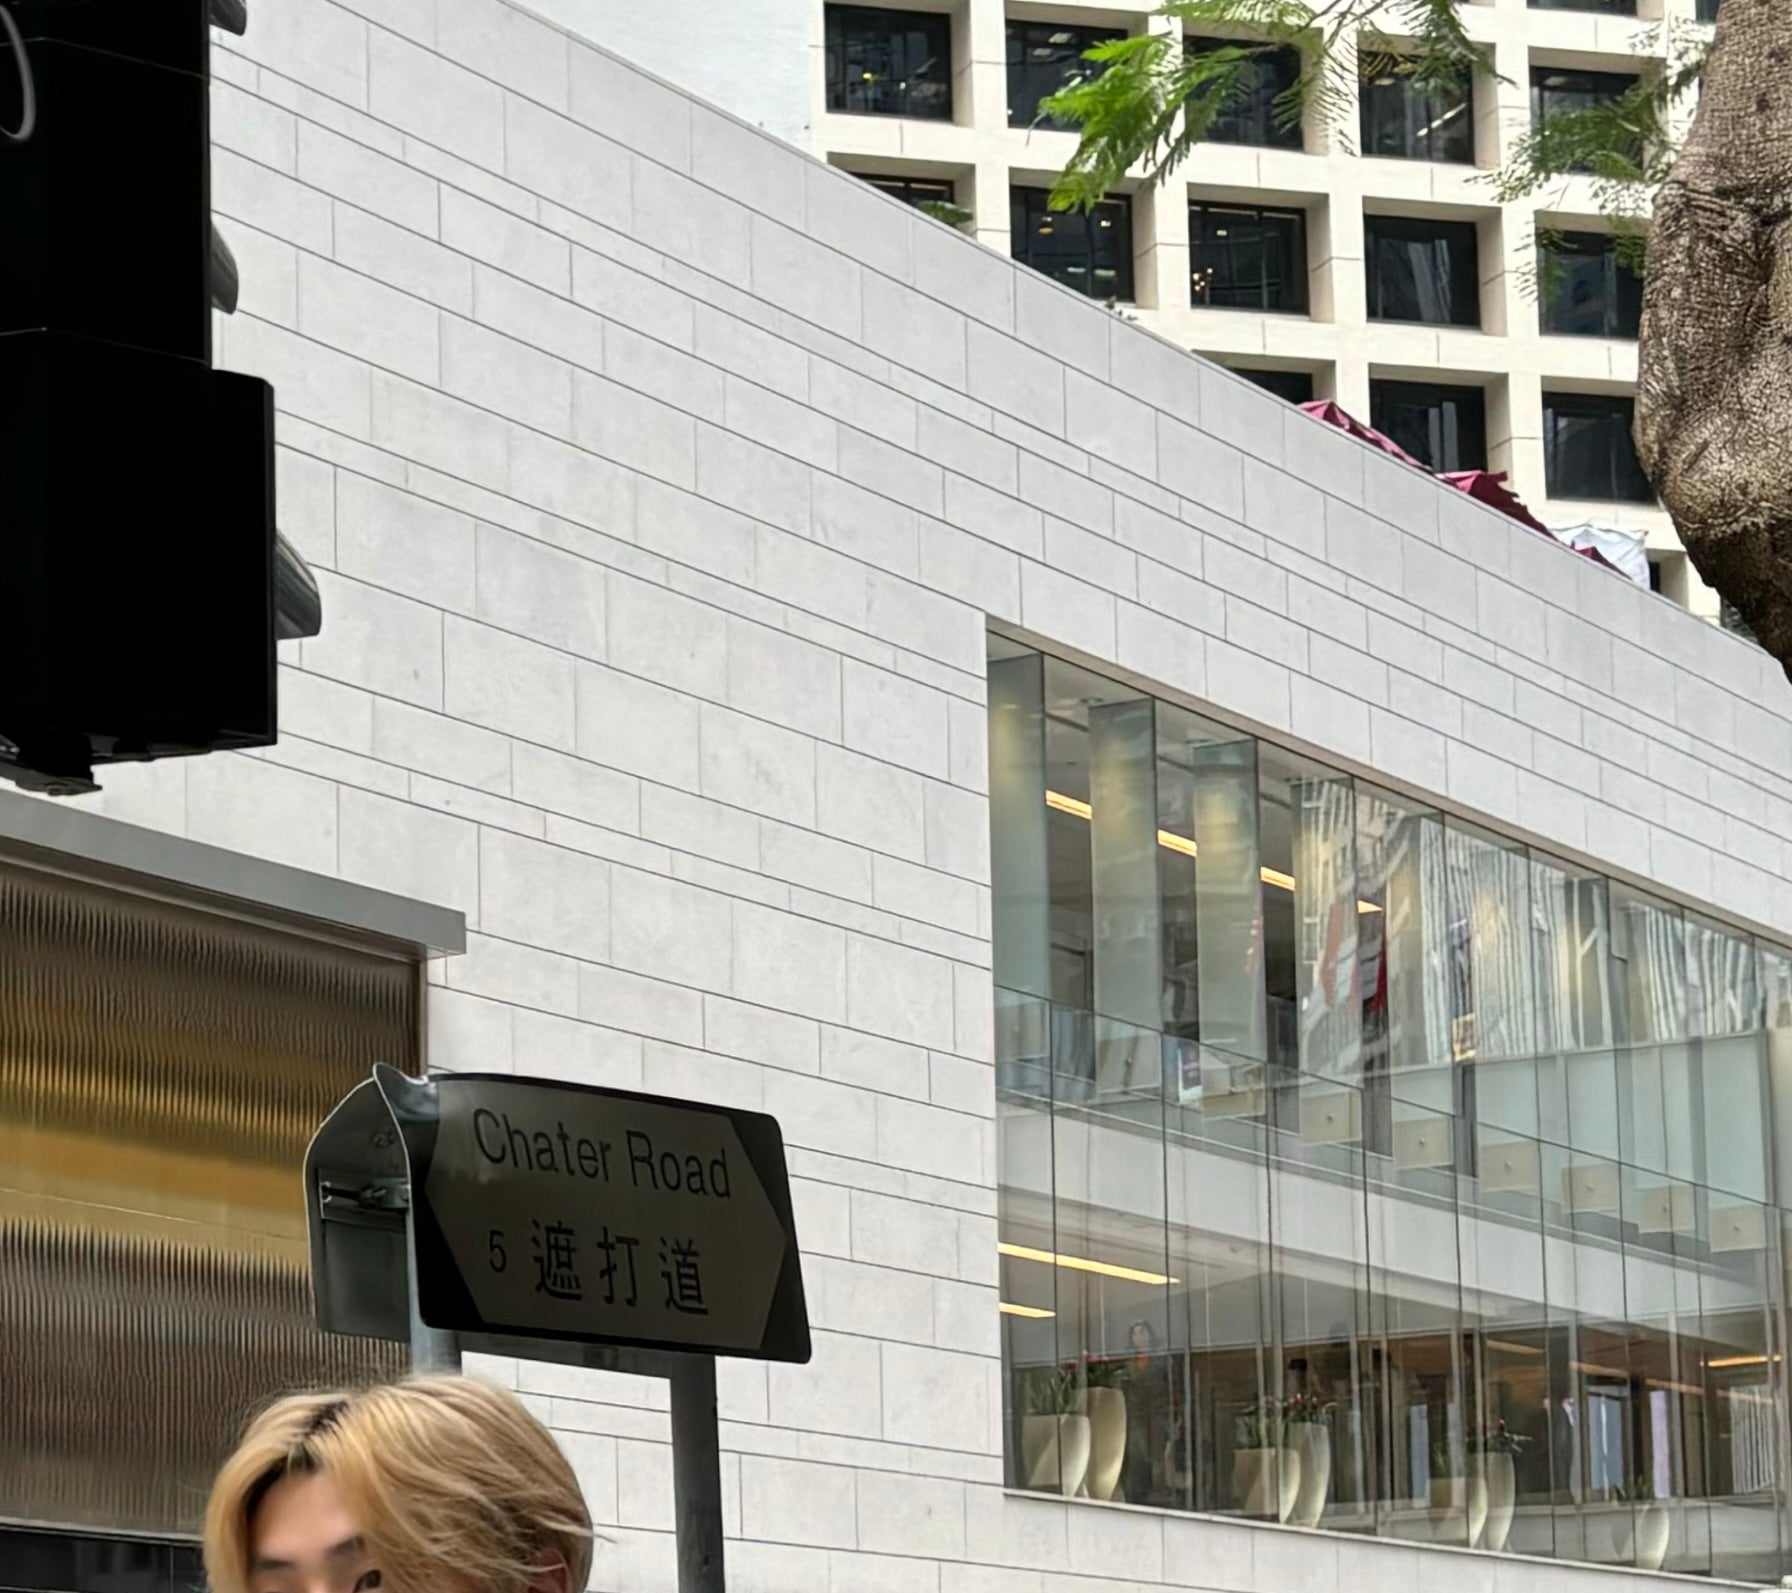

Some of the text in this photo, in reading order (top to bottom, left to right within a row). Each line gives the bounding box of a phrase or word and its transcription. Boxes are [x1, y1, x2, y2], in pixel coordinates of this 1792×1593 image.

[472, 1107, 731, 1199] Chater Road
[488, 1218, 709, 1316] 5 遮打道
